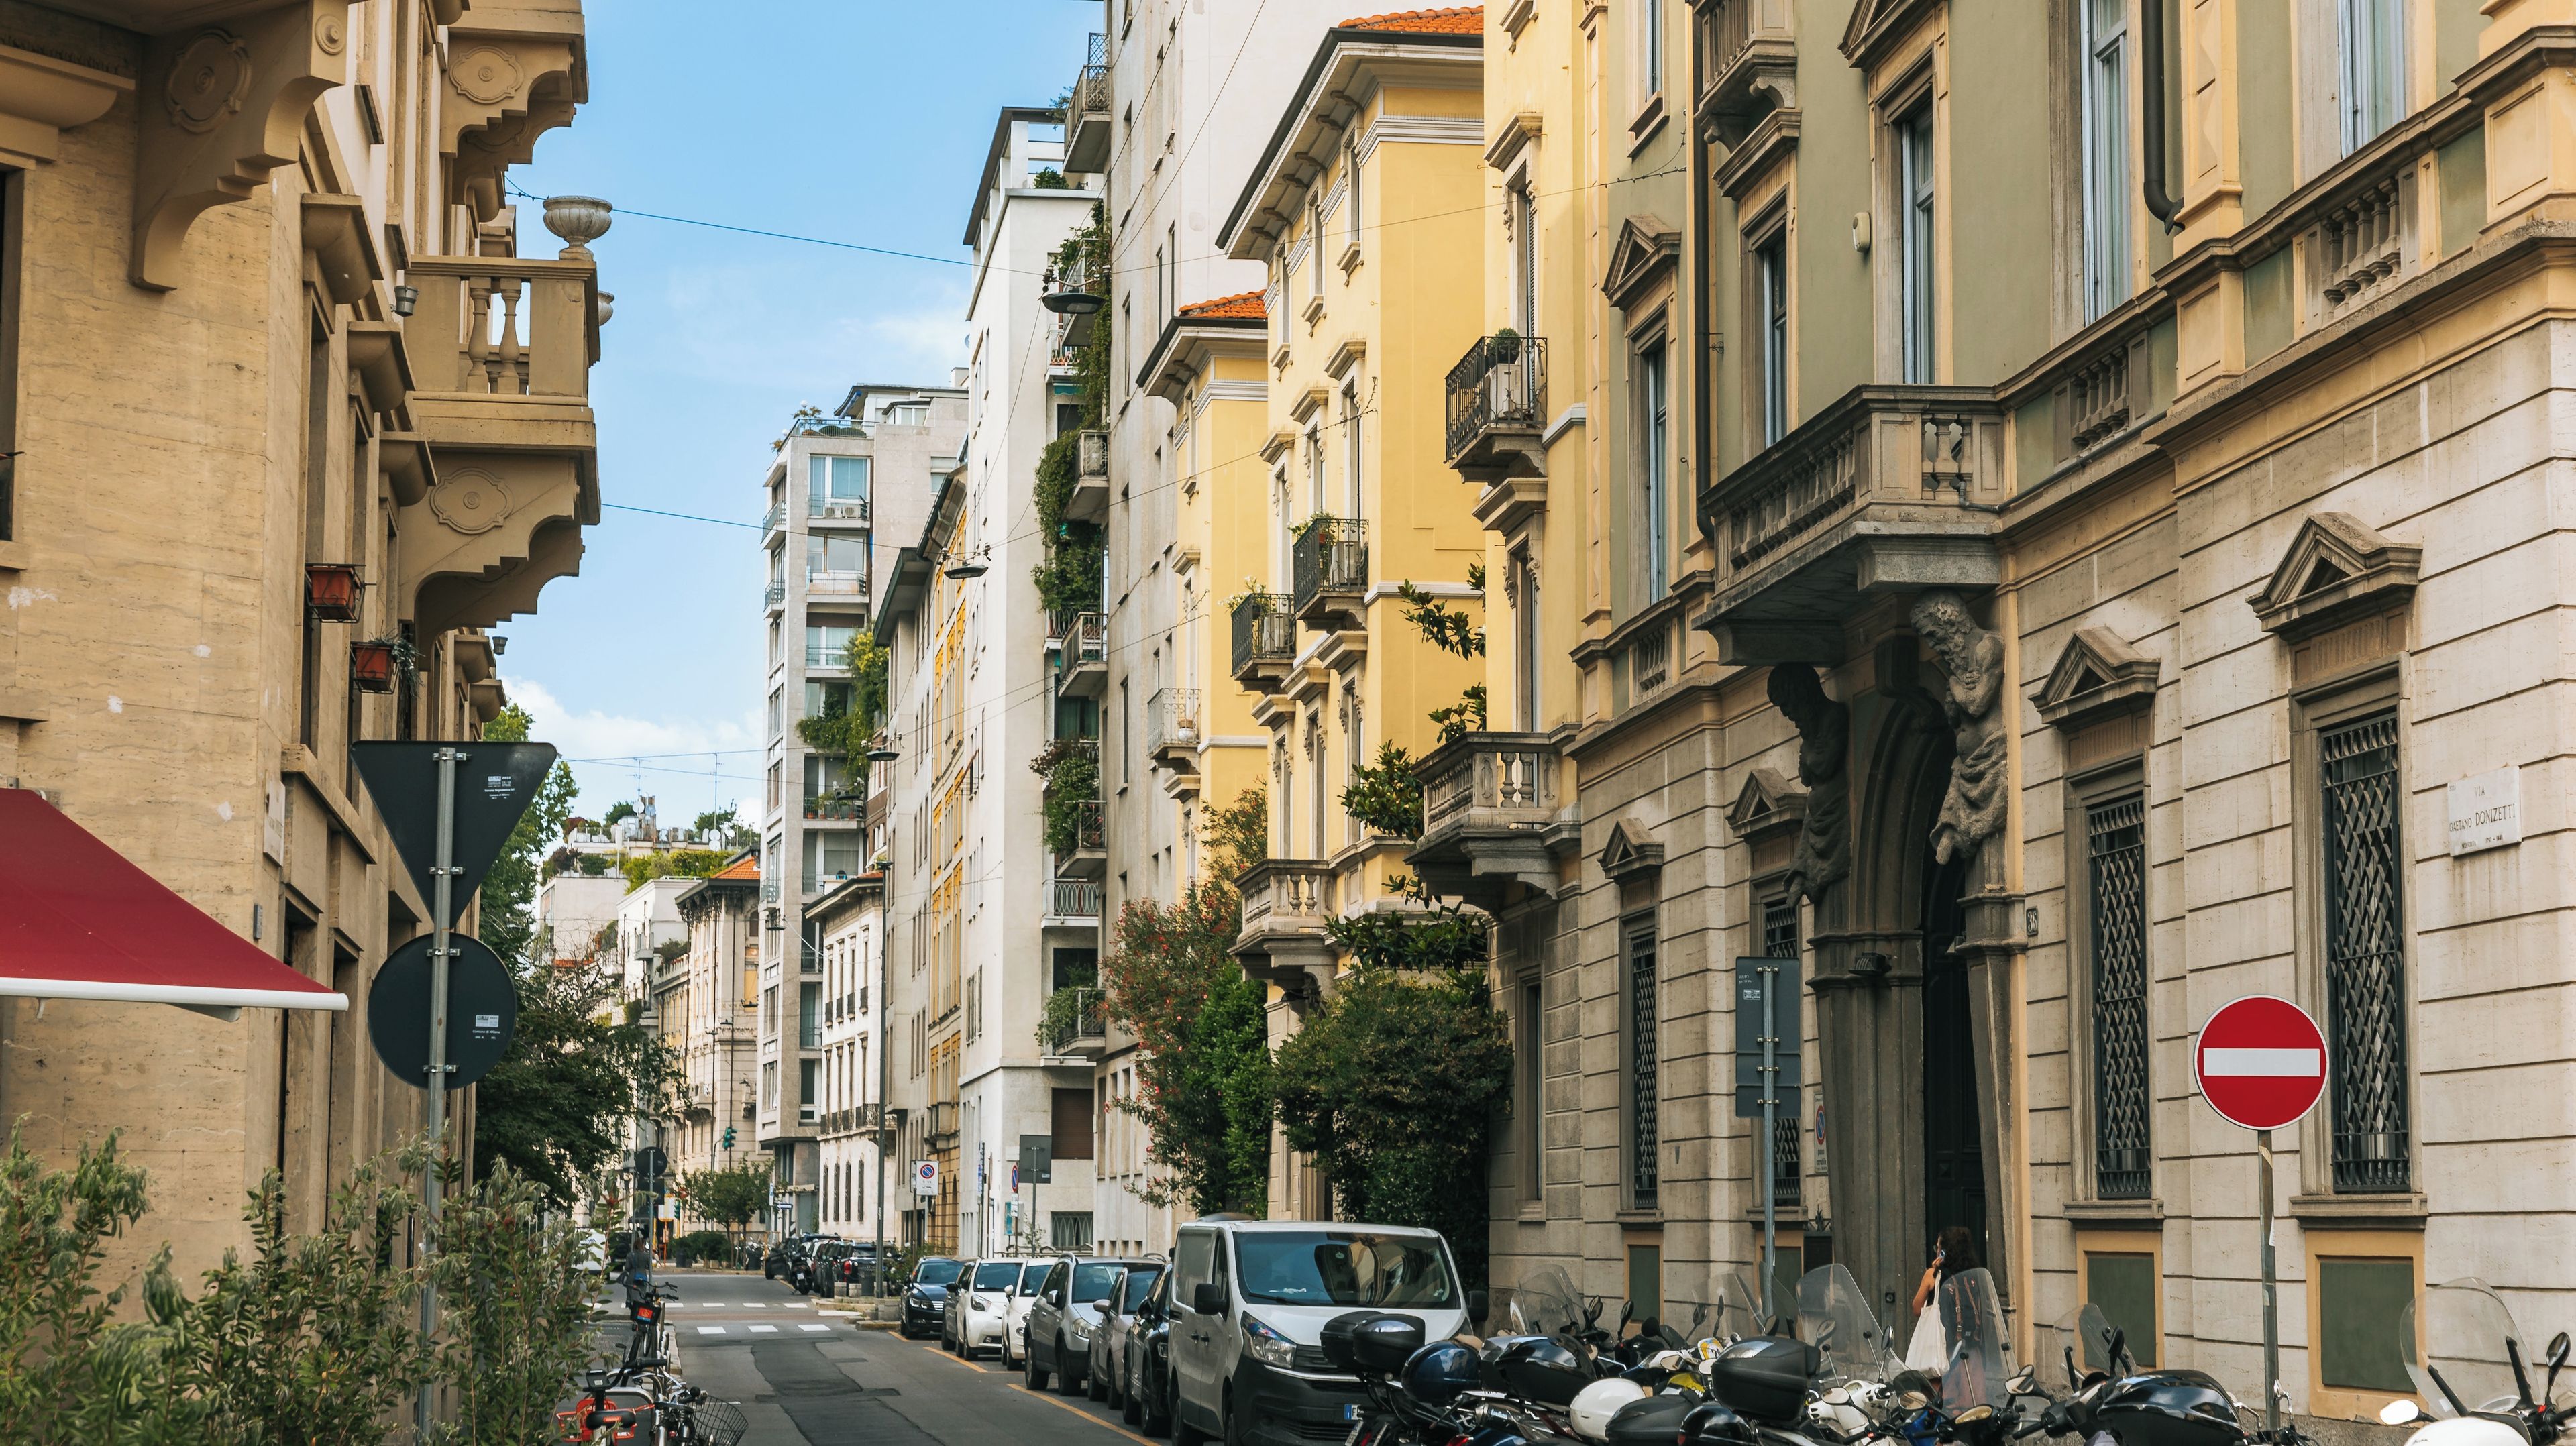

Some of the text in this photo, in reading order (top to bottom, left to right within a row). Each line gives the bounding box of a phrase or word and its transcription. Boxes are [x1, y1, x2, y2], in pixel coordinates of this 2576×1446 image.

[2475, 786, 2485, 797] VIA
[2475, 803, 2516, 826] DONIZETTI
[2027, 911, 2037, 932] 36
